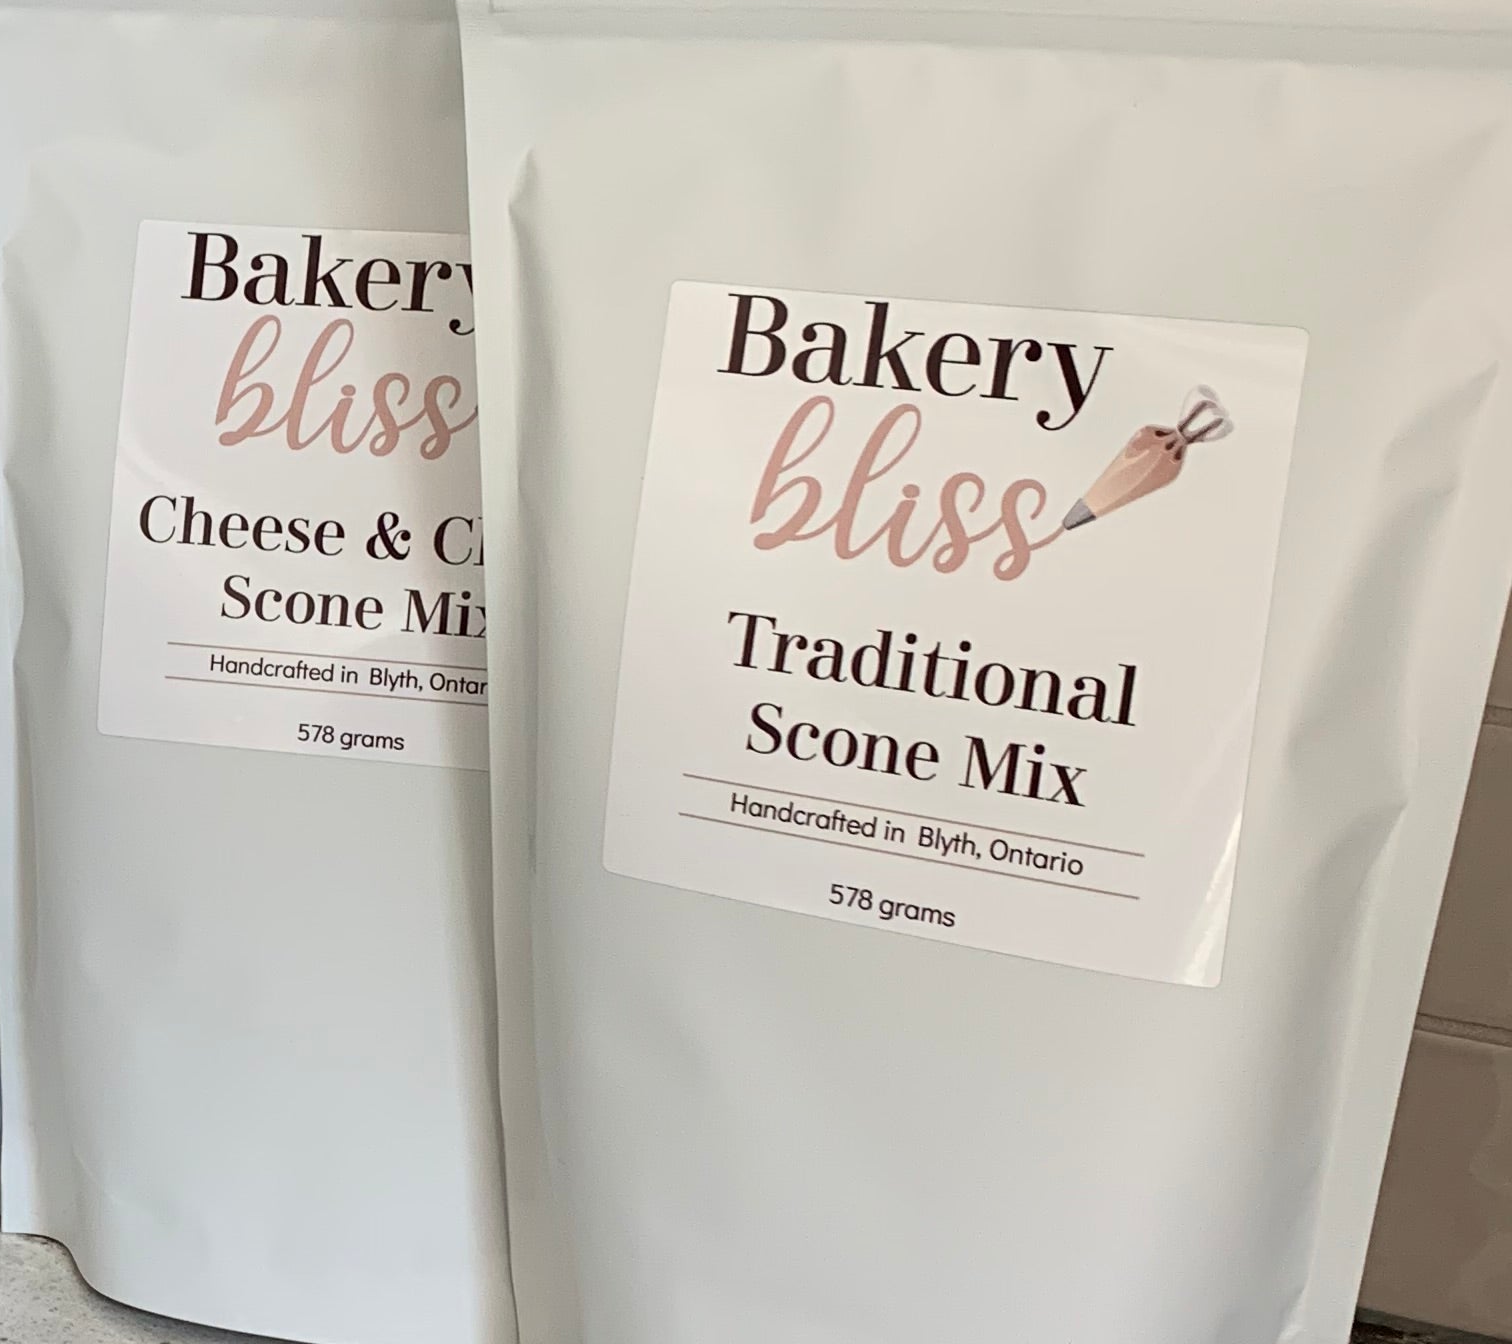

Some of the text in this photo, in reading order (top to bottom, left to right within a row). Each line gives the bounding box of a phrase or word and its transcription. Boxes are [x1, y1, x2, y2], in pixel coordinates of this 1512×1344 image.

[216, 315, 478, 460] bliss
[718, 294, 1114, 431] Bakery
[139, 495, 345, 556] Cheese
[366, 511, 411, 560] &
[750, 395, 1066, 582] bliss
[221, 575, 384, 630] Scone
[210, 654, 335, 683] Handcrafted
[341, 665, 359, 685] in
[370, 668, 424, 693] Blyth,
[728, 612, 1138, 726] Traditional
[297, 724, 405, 751] 578 grams
[746, 702, 1088, 807] Scone Mix
[730, 793, 1084, 876] Handcrafted in Blyth, Ontario
[829, 884, 956, 928] 578 grams
